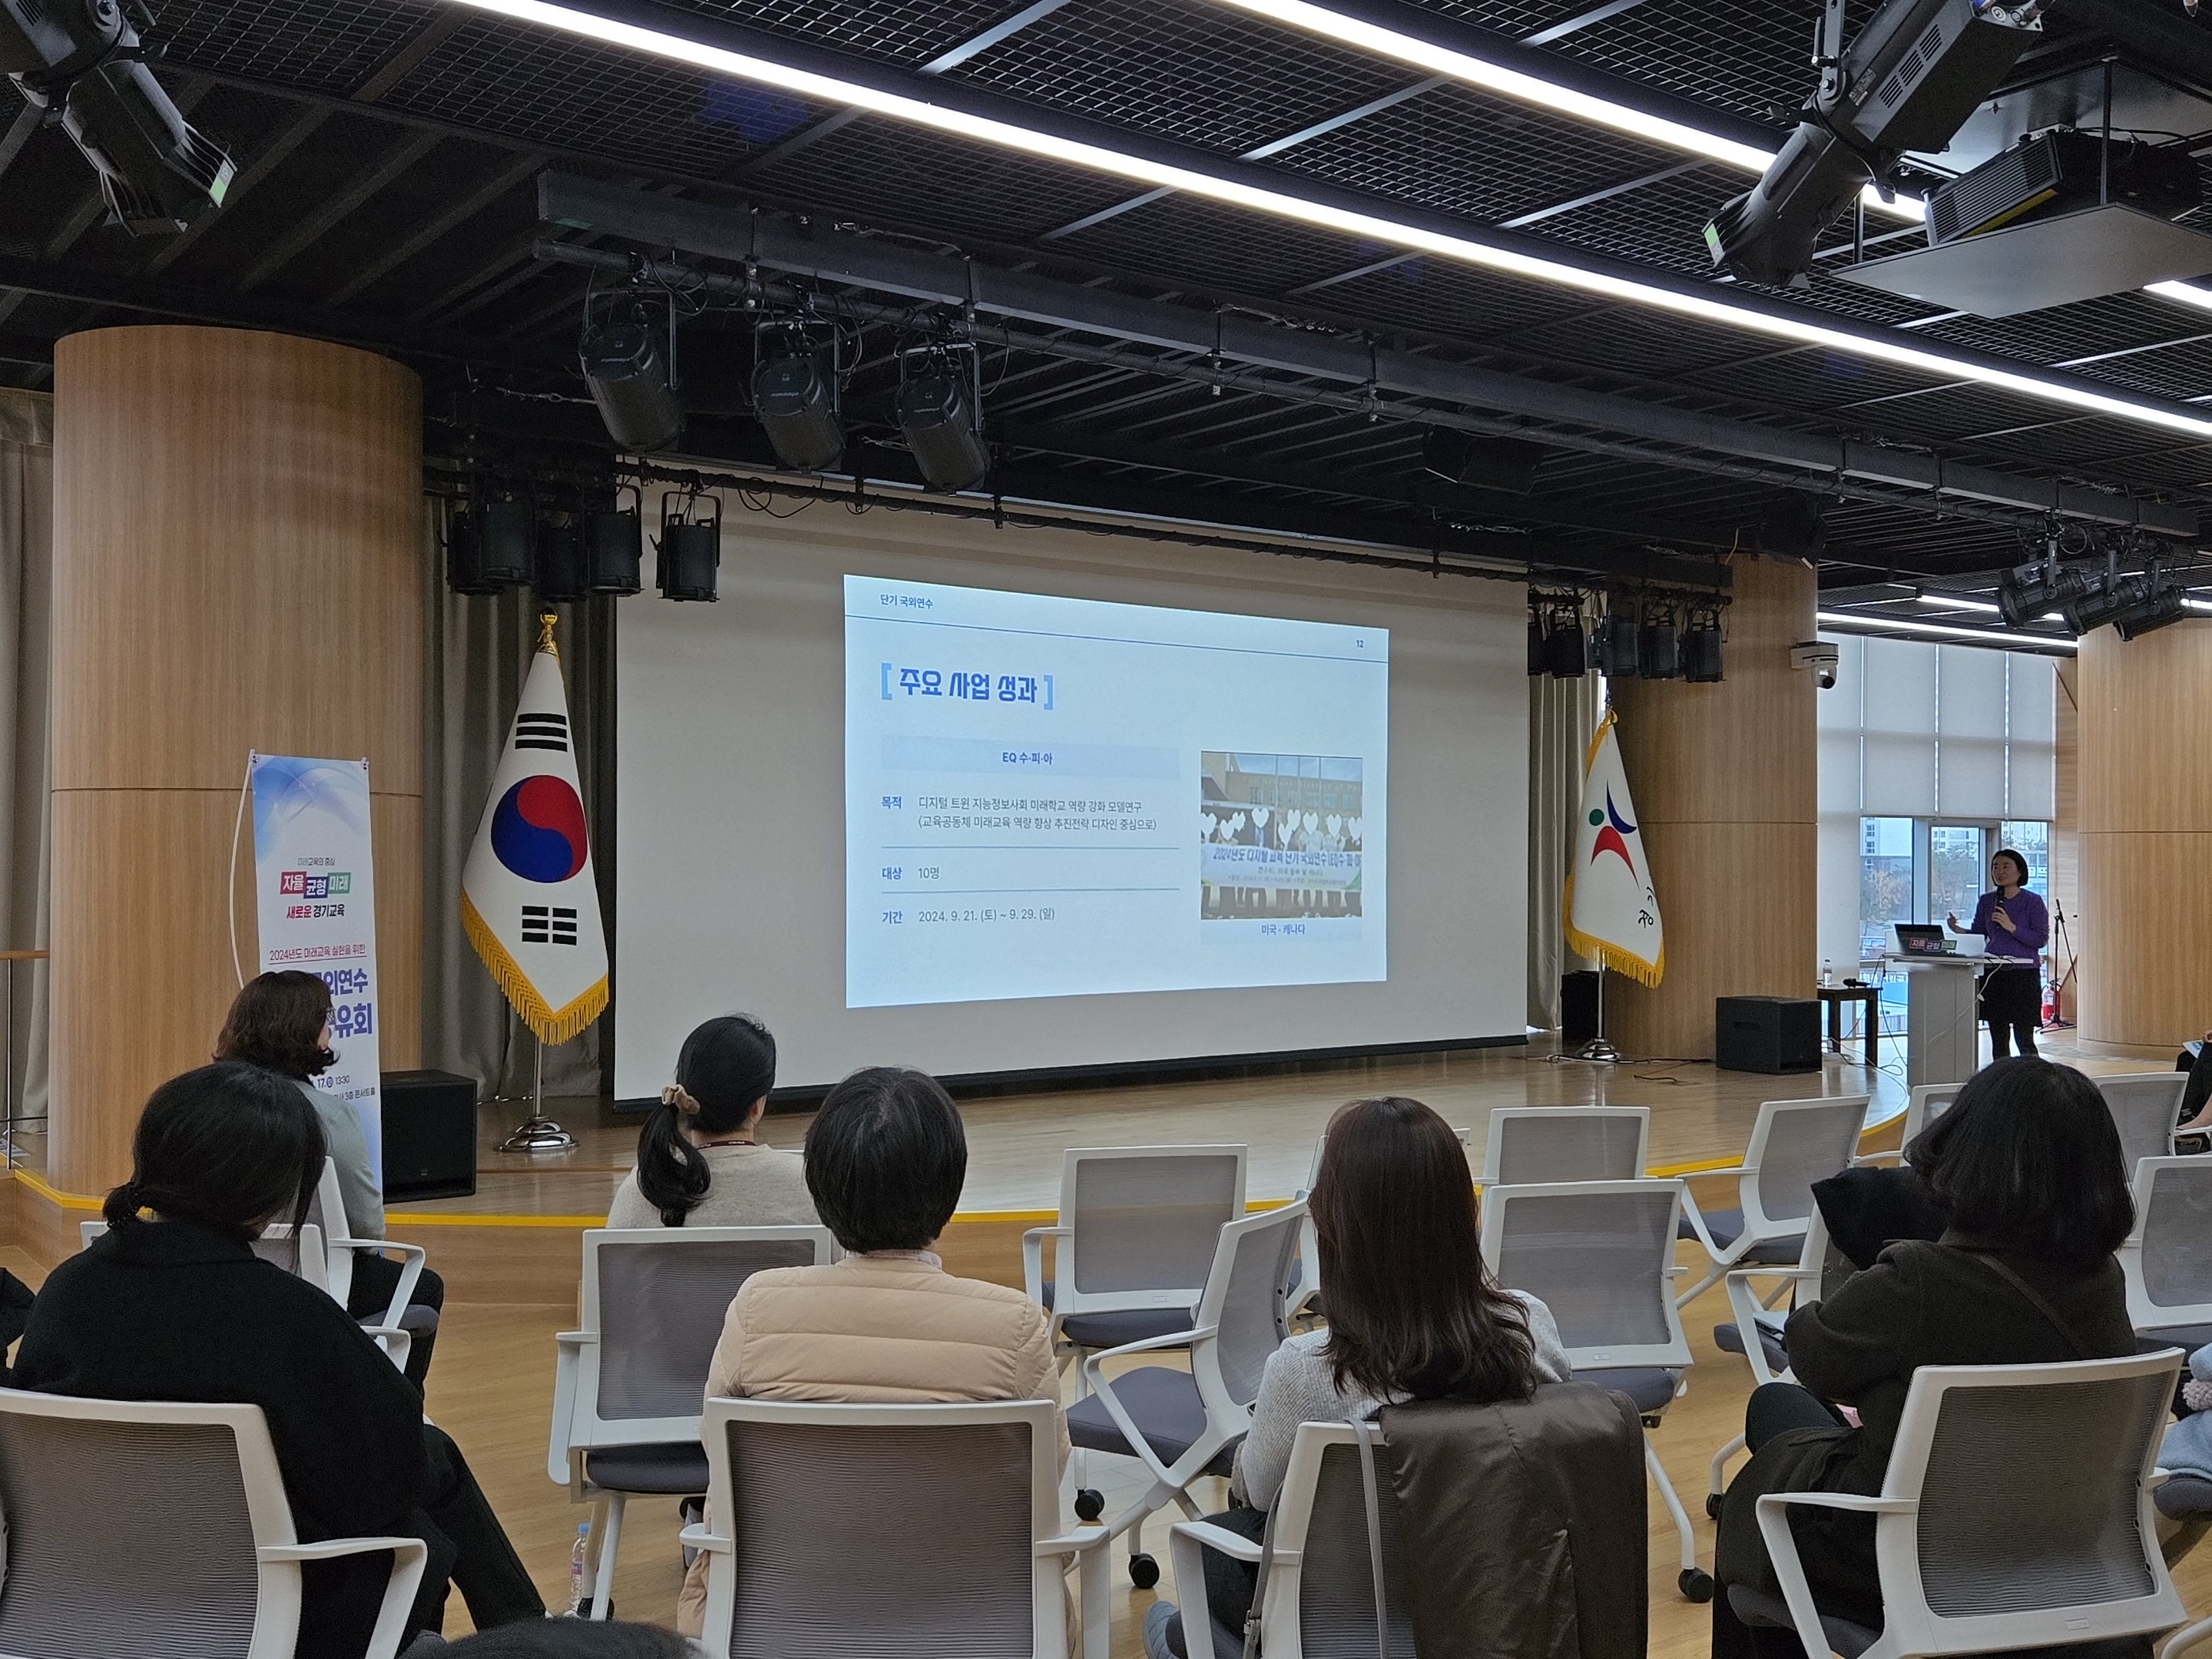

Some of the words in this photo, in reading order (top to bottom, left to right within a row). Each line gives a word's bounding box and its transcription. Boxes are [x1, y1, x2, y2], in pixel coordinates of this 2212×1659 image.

[881, 594, 898, 606] 단기
[900, 596, 933, 609] 국외연수
[899, 668, 942, 696] 주요
[949, 672, 990, 700] 사업
[997, 675, 1038, 703] 성과
[1002, 753, 1016, 763] EQ
[1019, 753, 1053, 765] 수·피·아
[882, 796, 902, 809] 목적
[919, 796, 947, 809] 디지털
[951, 797, 969, 810] 트윈
[973, 798, 1028, 811] 지능정보사회
[1031, 800, 1066, 812] 미래학교
[1068, 800, 1086, 812] 역량
[1088, 801, 1106, 813] 강화
[1108, 801, 1142, 813] 모델연구
[974, 816, 1011, 829] 미래교육
[1014, 817, 1031, 829] 역량
[1034, 817, 1051, 830] 향상
[1055, 819, 1089, 830] 추진전략
[1092, 819, 1118, 830] 디자인
[1120, 819, 1157, 831] 중심으로)
[882, 867, 902, 880] 대상
[919, 866, 939, 879] 10명
[283, 874, 304, 891] 자율
[306, 879, 326, 896] 균형
[329, 875, 348, 891] 미래
[286, 906, 312, 919] 새로운
[313, 904, 345, 918] 경기교육
[882, 911, 902, 924] 기간
[919, 911, 949, 922] 2024.
[951, 911, 960, 922] 9.
[963, 910, 978, 922] 21.
[980, 909, 997, 922] (토)
[1009, 909, 1018, 920] 9.
[1022, 909, 1037, 920] 29.
[1039, 907, 1055, 921] (일)
[1261, 923, 1277, 935] 미국
[270, 949, 303, 961] 2024년도
[304, 945, 330, 959] 미래교육
[332, 944, 351, 955] 실현을
[353, 944, 366, 954] 위한
[314, 968, 369, 996] 외연수
[355, 1087, 376, 1099] 콘서트홀
